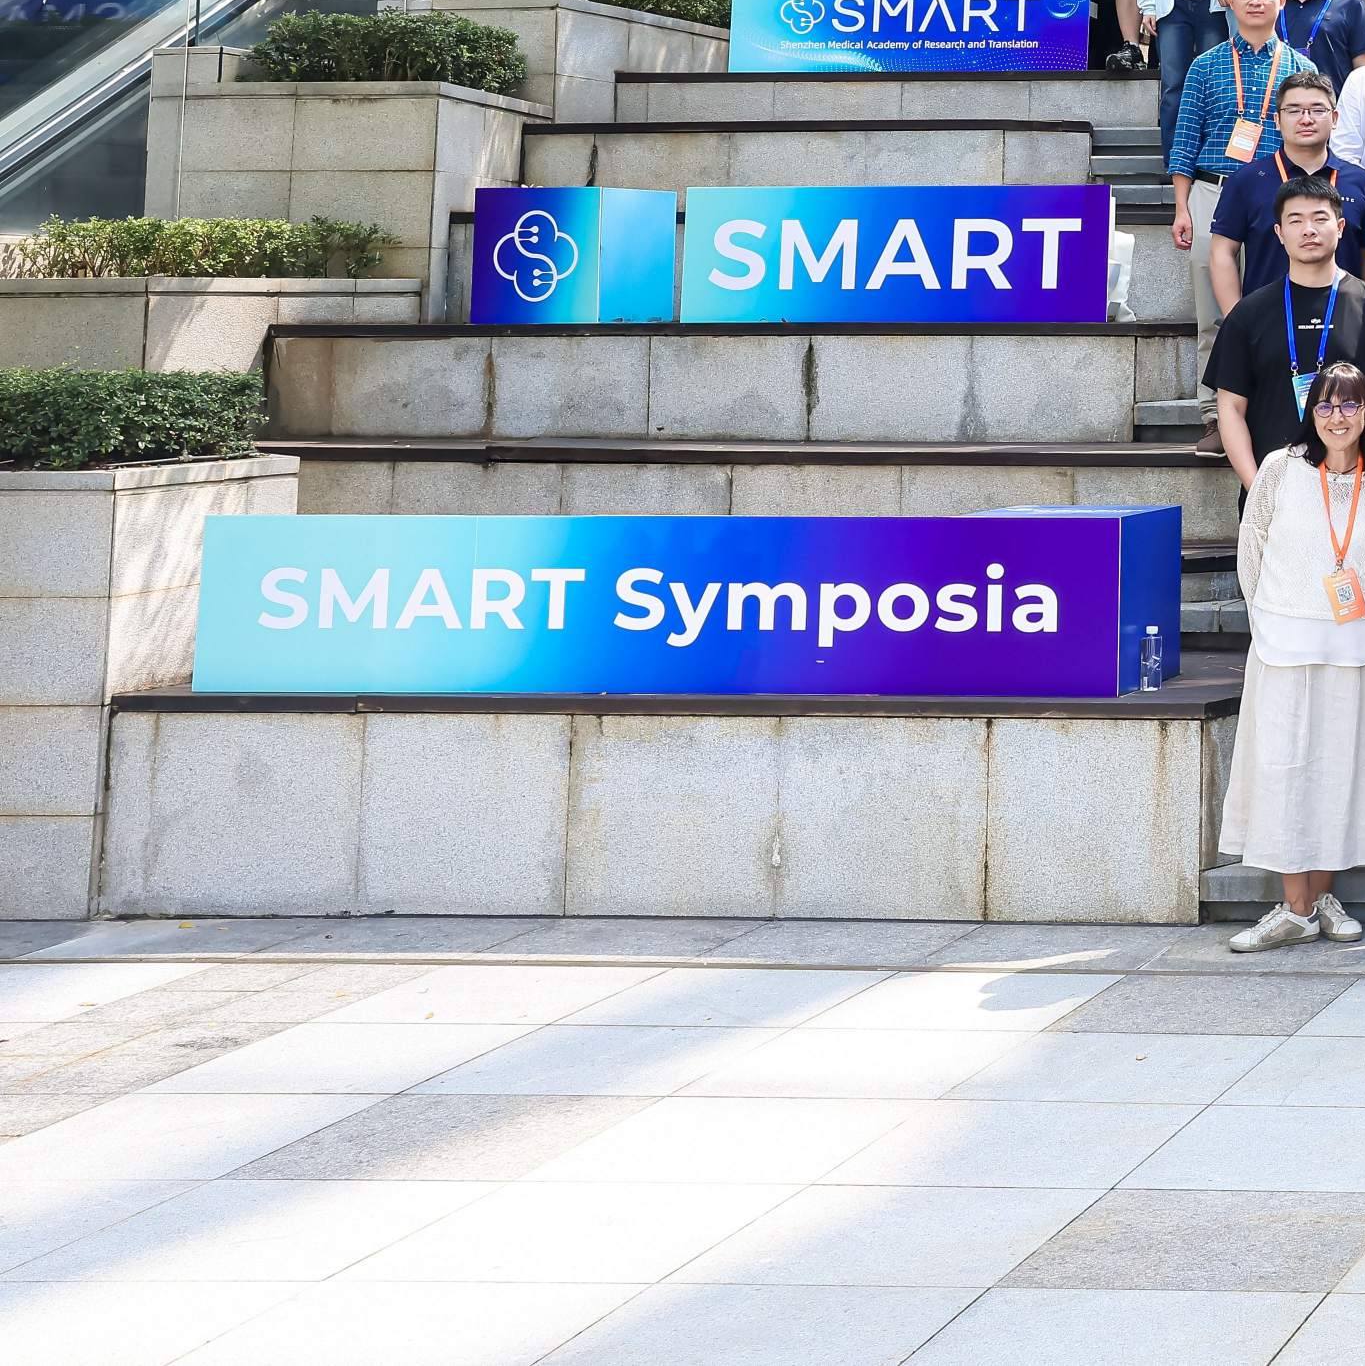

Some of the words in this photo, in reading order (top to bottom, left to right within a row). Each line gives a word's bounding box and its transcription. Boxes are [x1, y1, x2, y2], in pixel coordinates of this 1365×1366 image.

[780, 40, 826, 49] Shenzhen
[827, 40, 864, 49] Medical
[866, 40, 910, 51] Academy
[912, 39, 922, 49] of
[924, 39, 966, 49] Research
[967, 39, 986, 49] and
[987, 39, 1039, 49] Translation
[709, 218, 1082, 290] SMART
[259, 567, 585, 629] SMART
[614, 563, 1058, 648] Symposia
